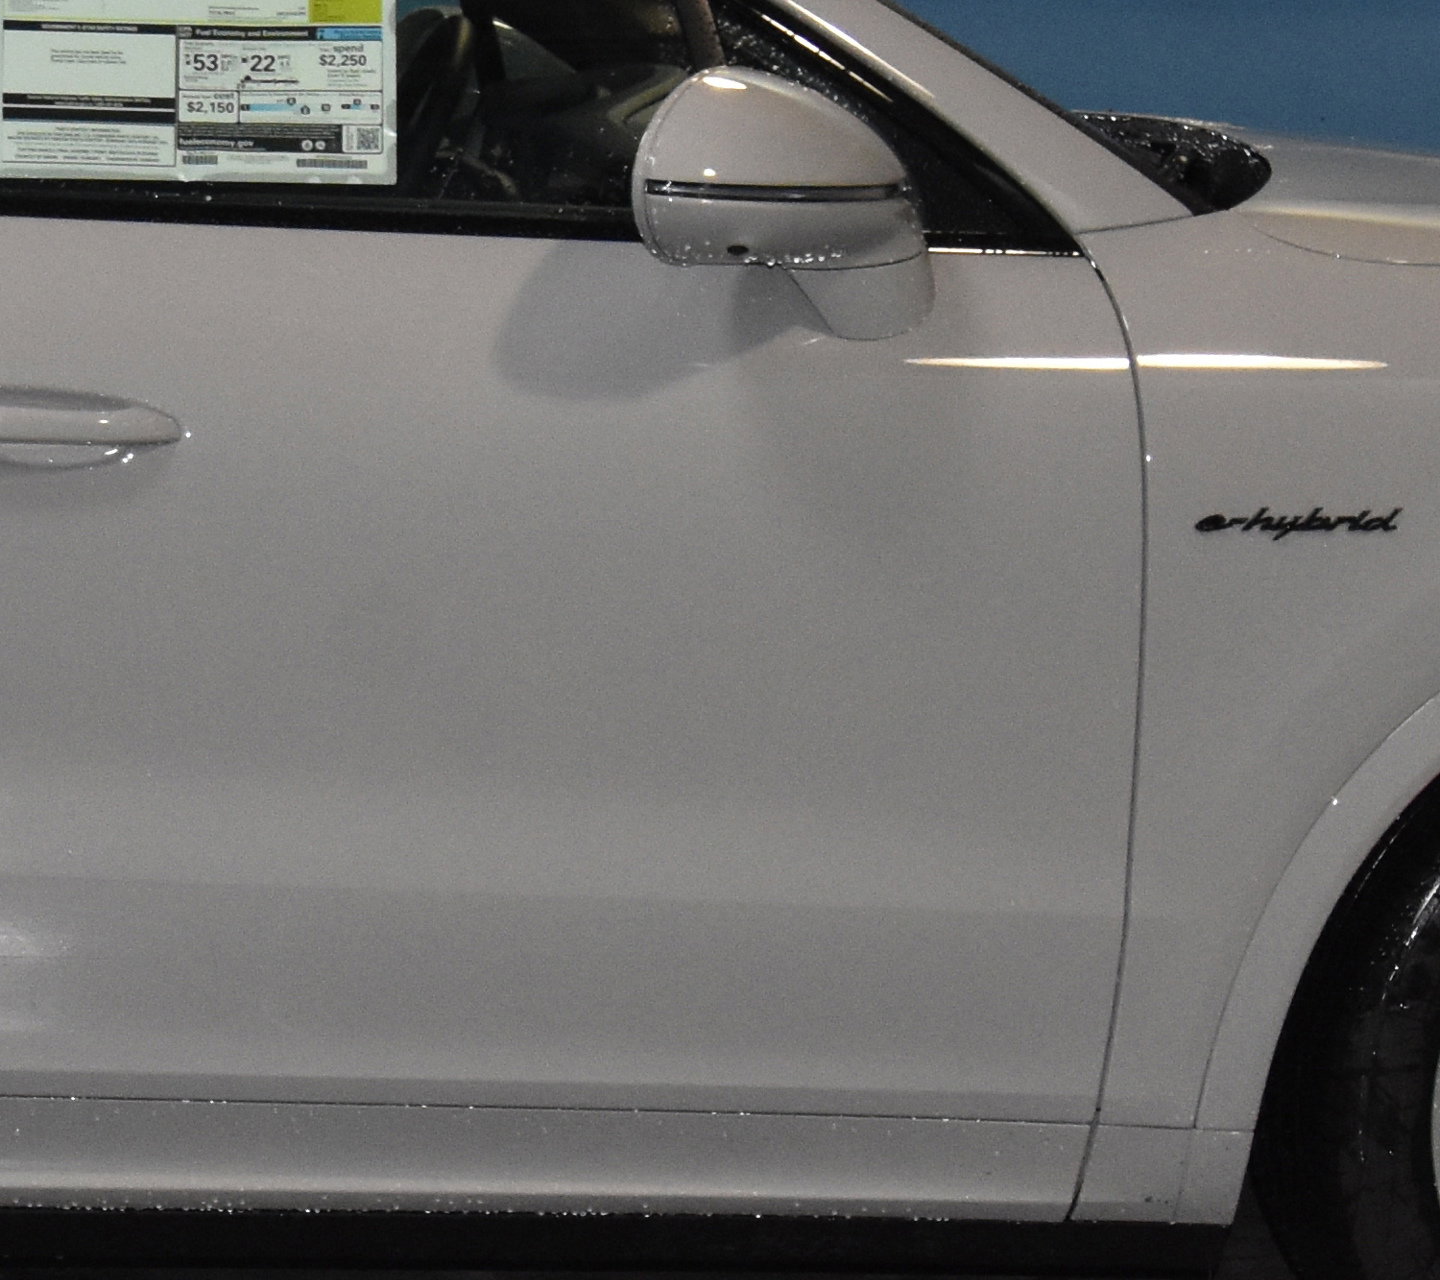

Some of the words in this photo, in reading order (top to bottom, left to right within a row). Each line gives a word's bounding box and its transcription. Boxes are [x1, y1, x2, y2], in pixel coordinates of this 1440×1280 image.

[333, 44, 364, 53] spend
[193, 53, 219, 72] 53
[250, 54, 276, 72] 22
[319, 53, 367, 67] $2,250
[187, 101, 235, 114] $2,150
